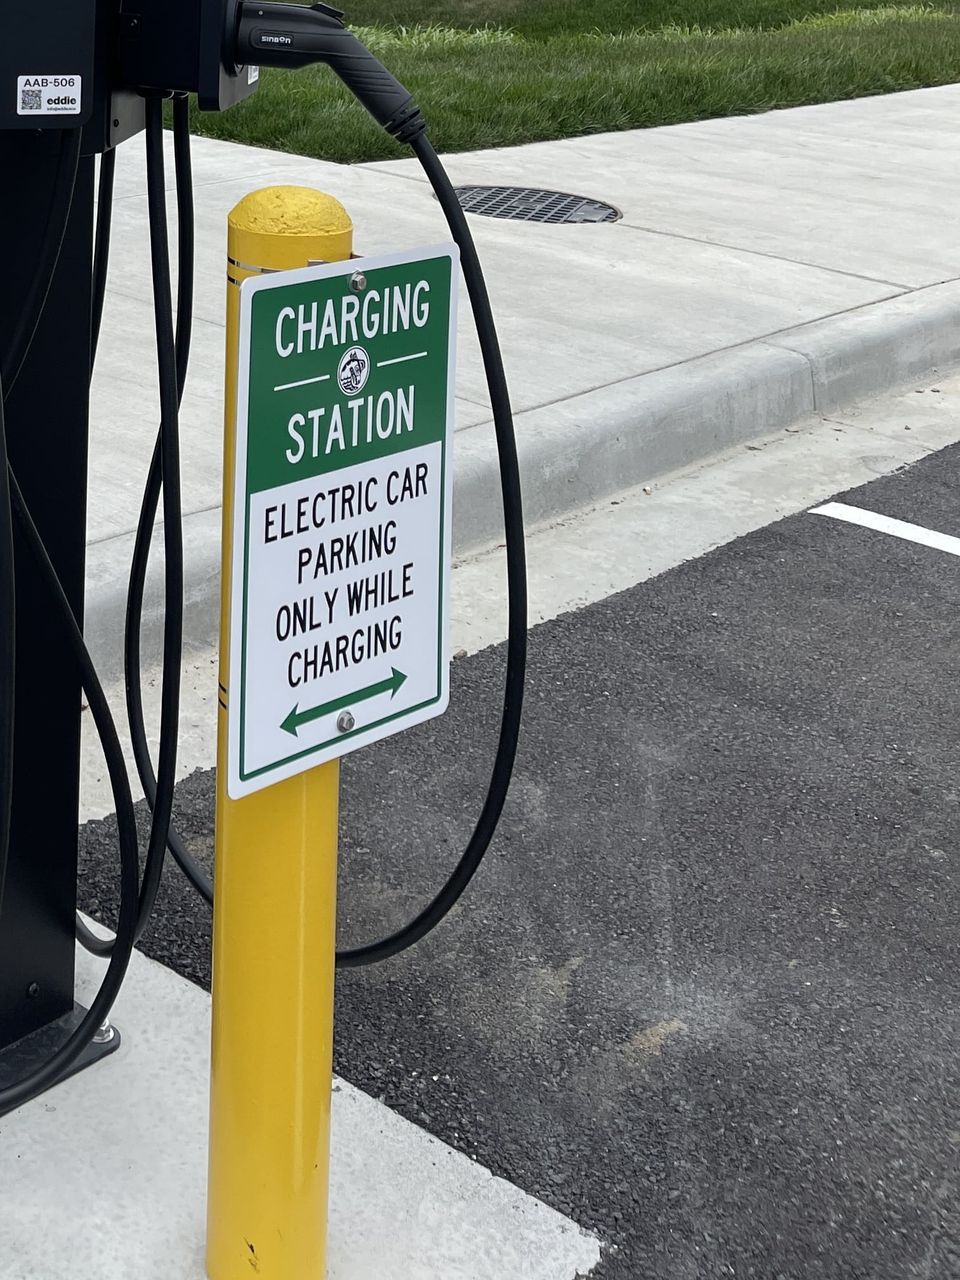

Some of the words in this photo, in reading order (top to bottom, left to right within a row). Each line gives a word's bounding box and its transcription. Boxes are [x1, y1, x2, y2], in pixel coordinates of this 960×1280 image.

[23, 78, 76, 88] AAB-506
[46, 96, 77, 105] eddie
[274, 279, 431, 358] CHARGING
[285, 384, 415, 465] STATION
[264, 476, 378, 544] ELECTRIC
[386, 462, 428, 506] CAR
[297, 520, 397, 585] PARKING
[276, 588, 339, 642] ONLY
[346, 562, 415, 617] WHILE
[288, 615, 402, 689] CHARGING
